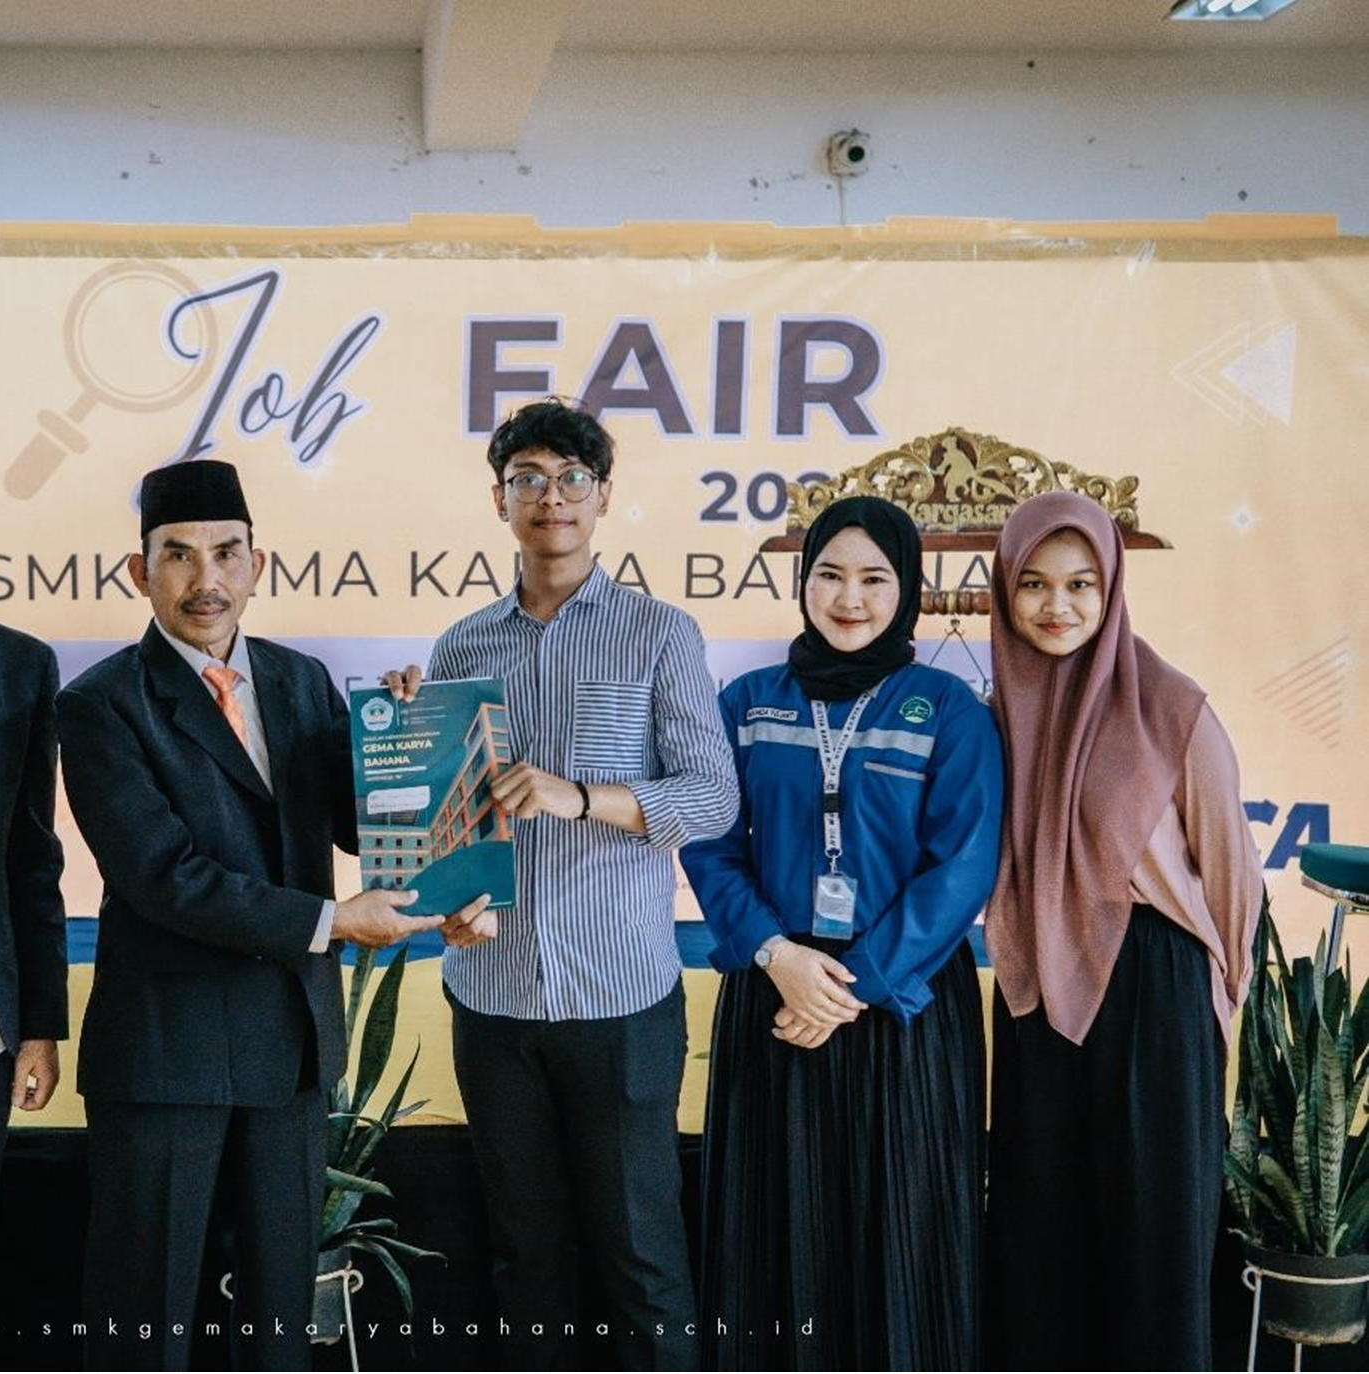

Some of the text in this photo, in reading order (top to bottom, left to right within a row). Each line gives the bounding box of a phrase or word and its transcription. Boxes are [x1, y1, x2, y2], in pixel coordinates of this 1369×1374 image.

[468, 319, 880, 436] FAIR
[363, 739, 433, 753] GEMA KARYA
[364, 755, 410, 767] BAHANA
